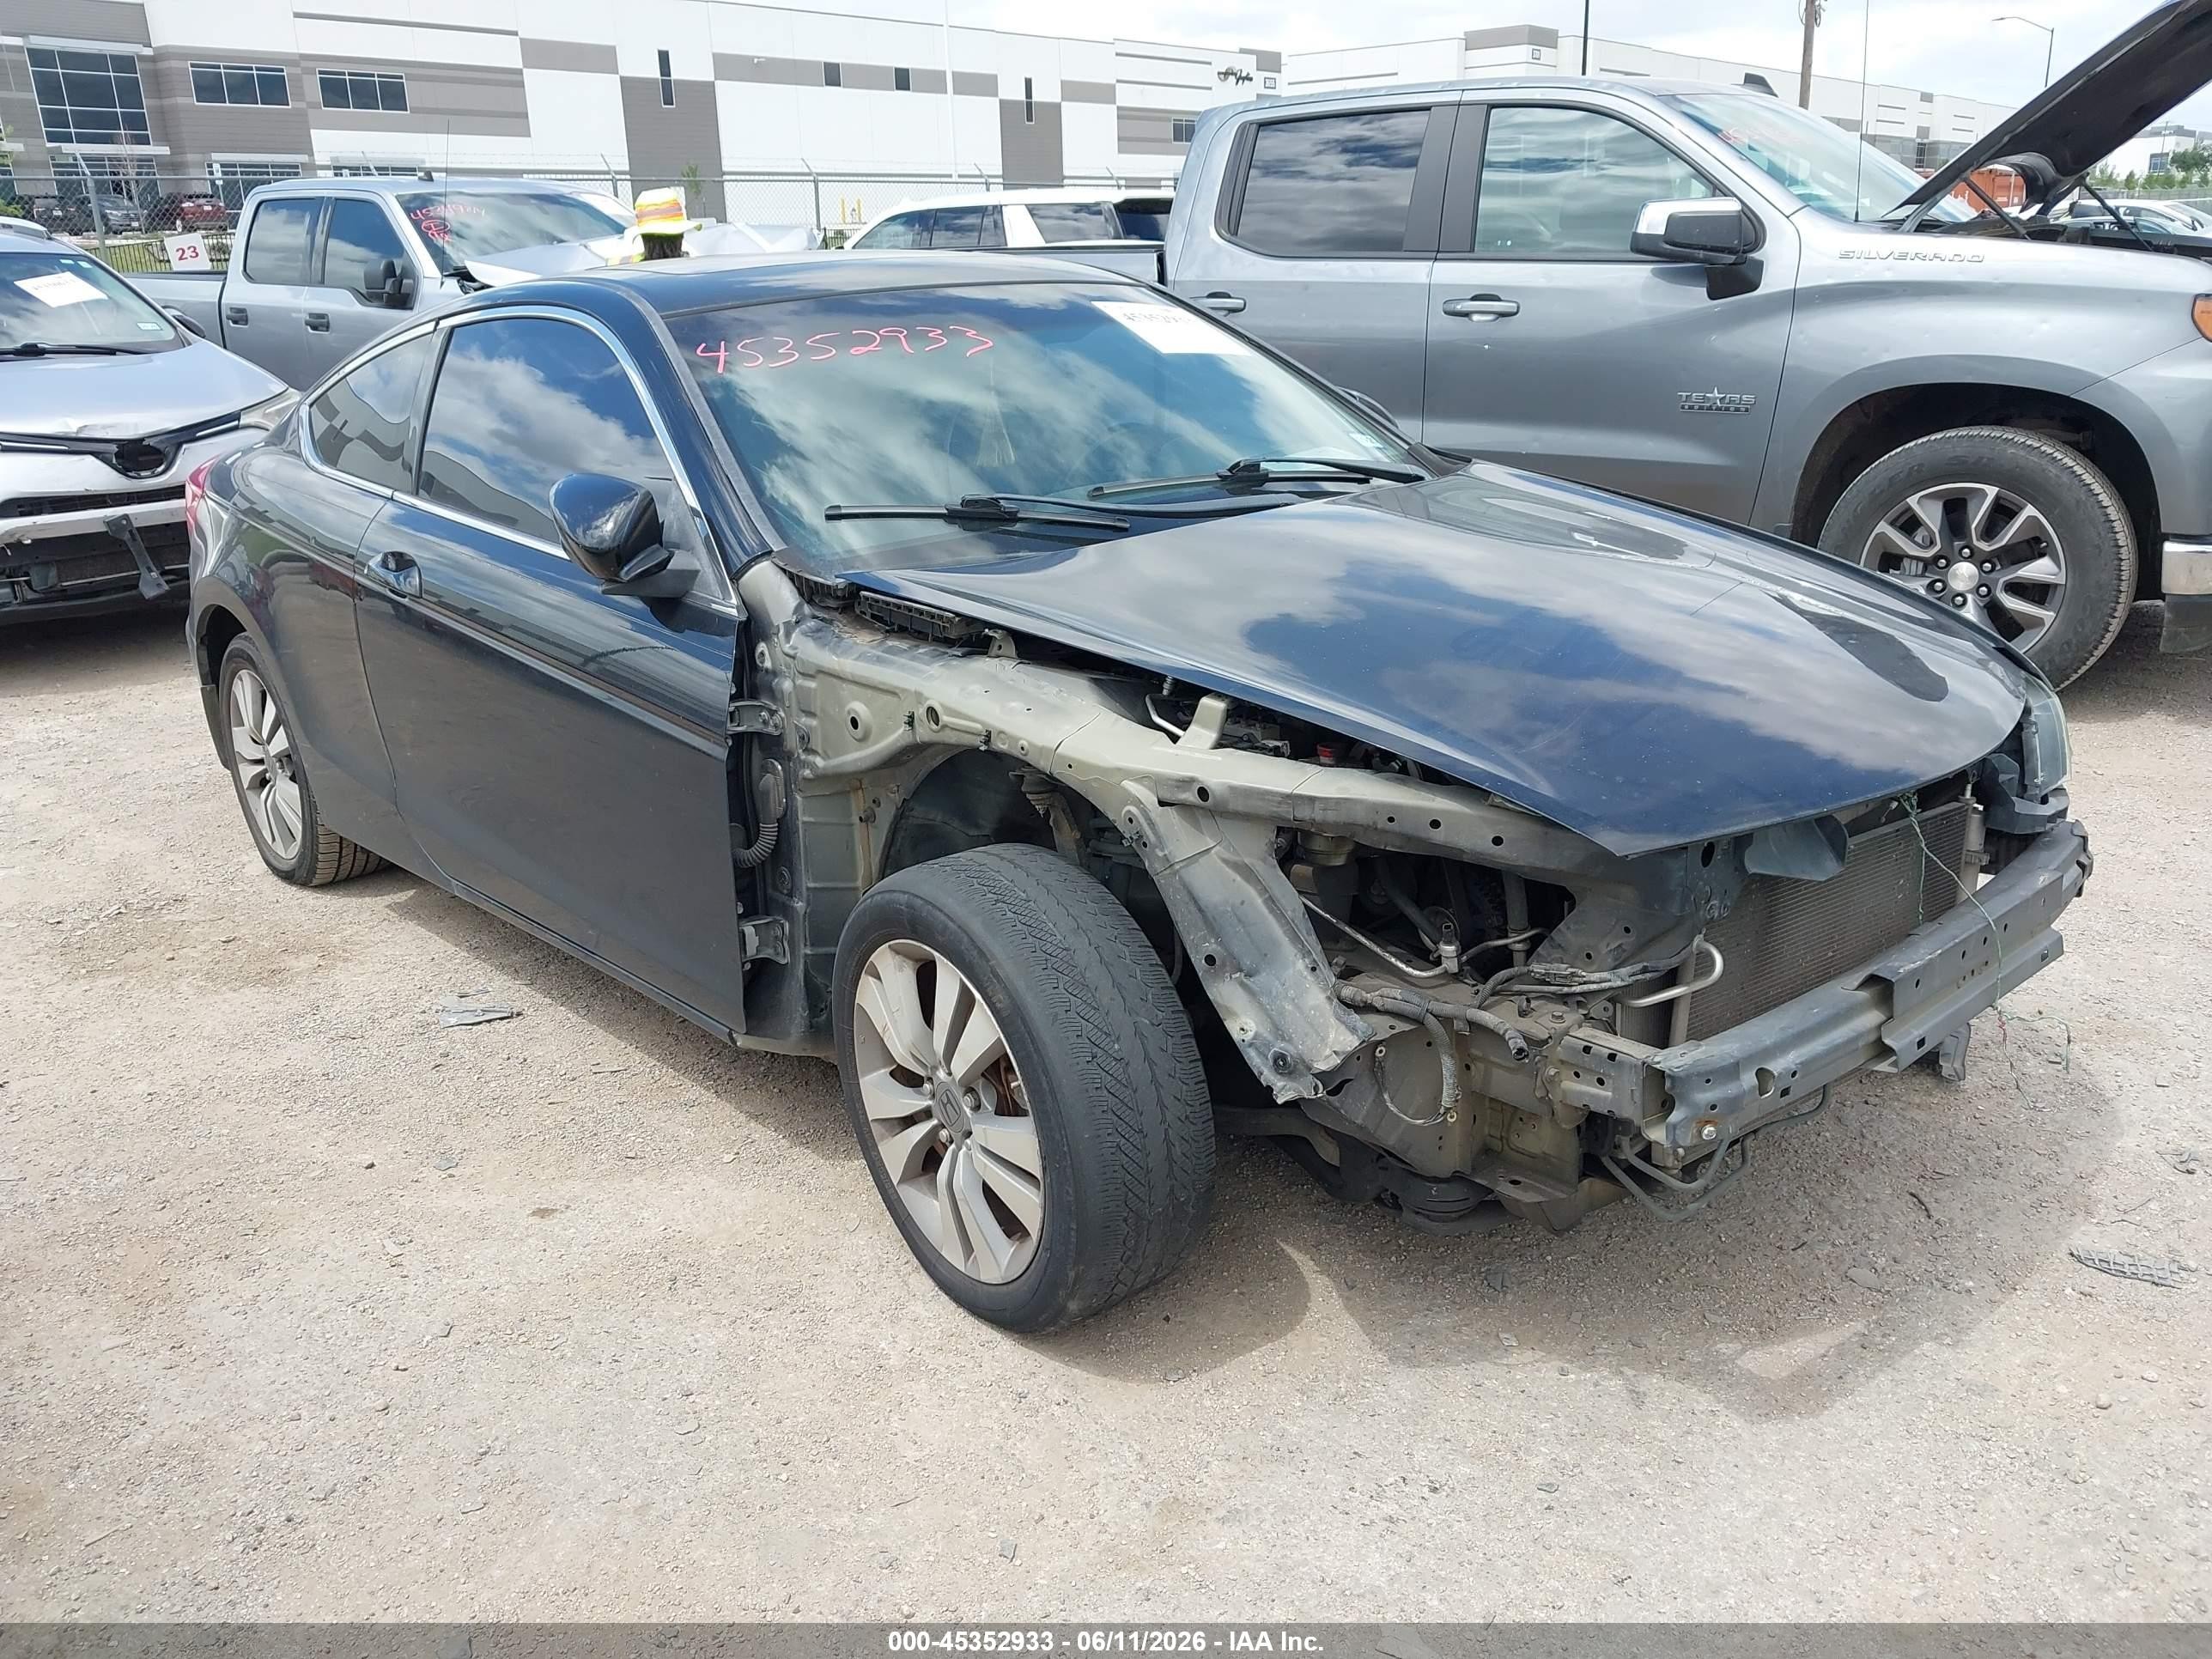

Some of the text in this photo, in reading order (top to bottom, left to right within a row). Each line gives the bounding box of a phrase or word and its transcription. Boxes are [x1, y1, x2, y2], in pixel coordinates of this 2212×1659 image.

[175, 246, 199, 261] 23
[1838, 250, 1985, 263] SILVERADO
[696, 325, 994, 374] 45352933
